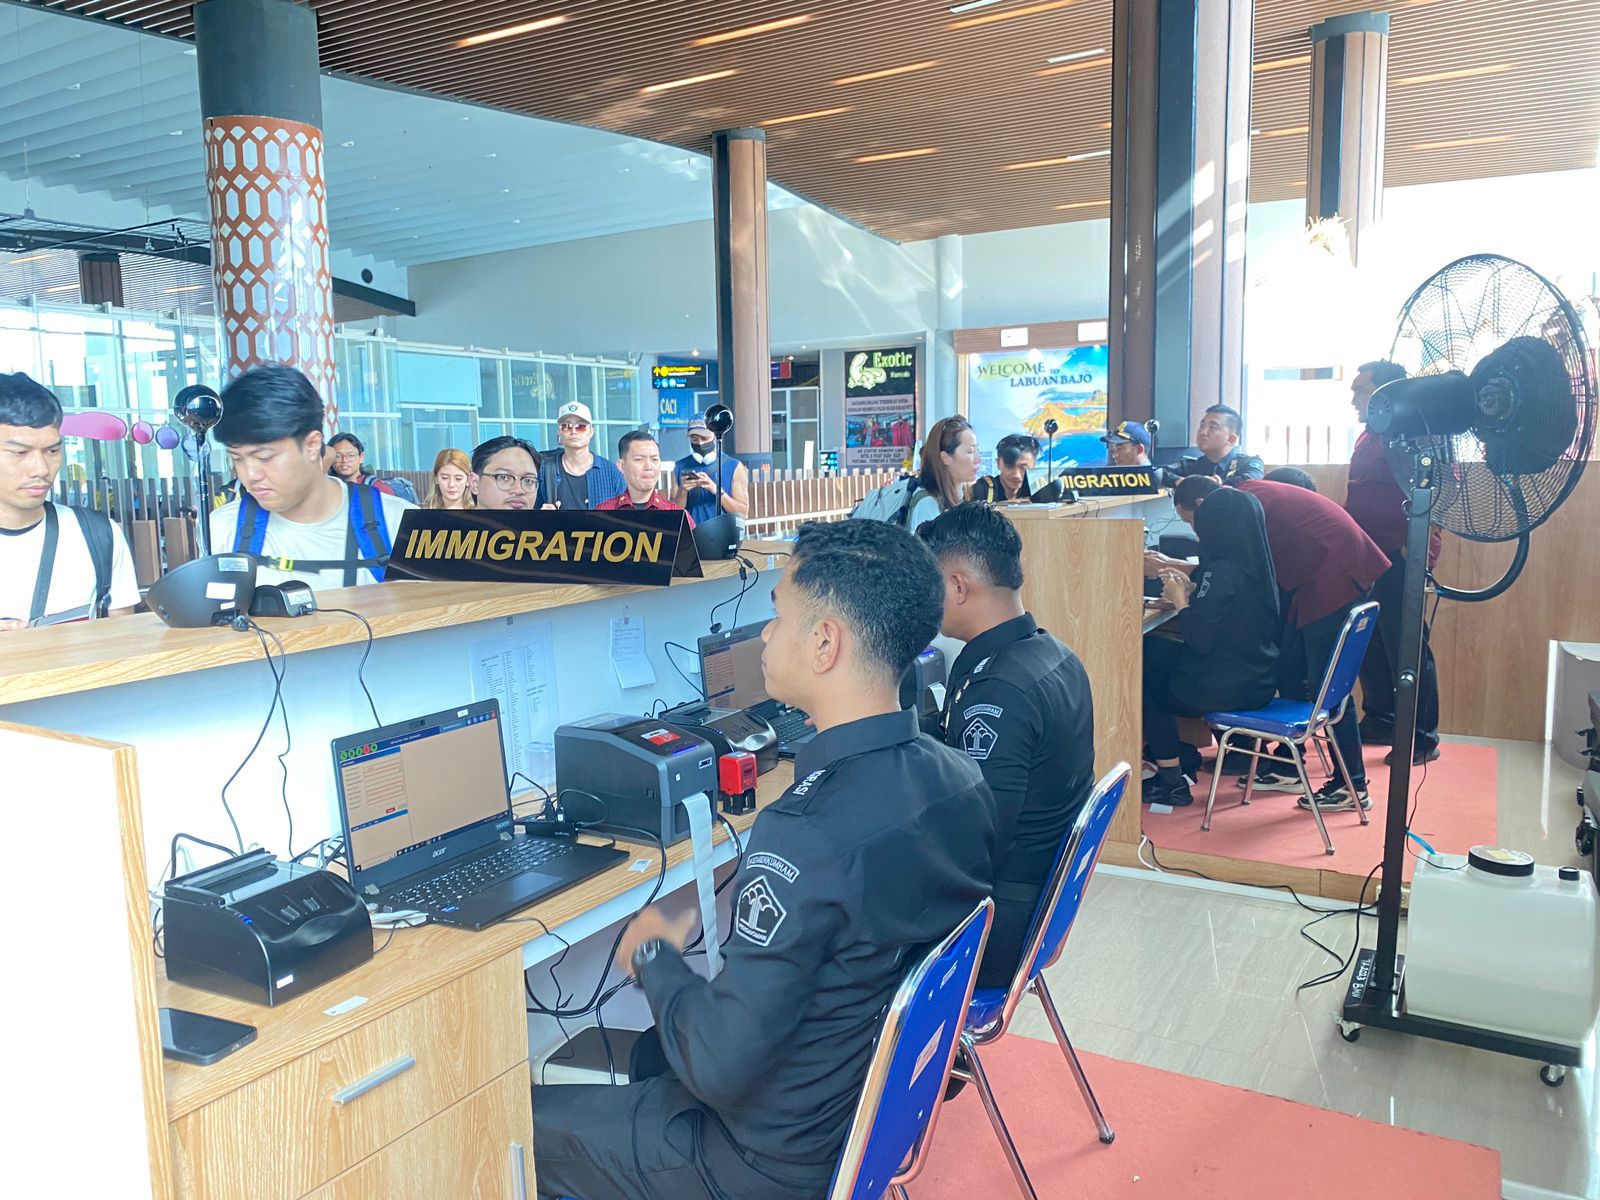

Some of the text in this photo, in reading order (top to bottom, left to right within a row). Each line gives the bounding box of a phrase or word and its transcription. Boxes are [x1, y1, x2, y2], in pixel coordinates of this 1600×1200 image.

[873, 351, 912, 368] Exotic
[976, 361, 1046, 379] WELCOME
[1010, 373, 1093, 388] LABUAN BAJO
[404, 529, 663, 563] IMMIGRATION
[432, 846, 448, 858] acer
